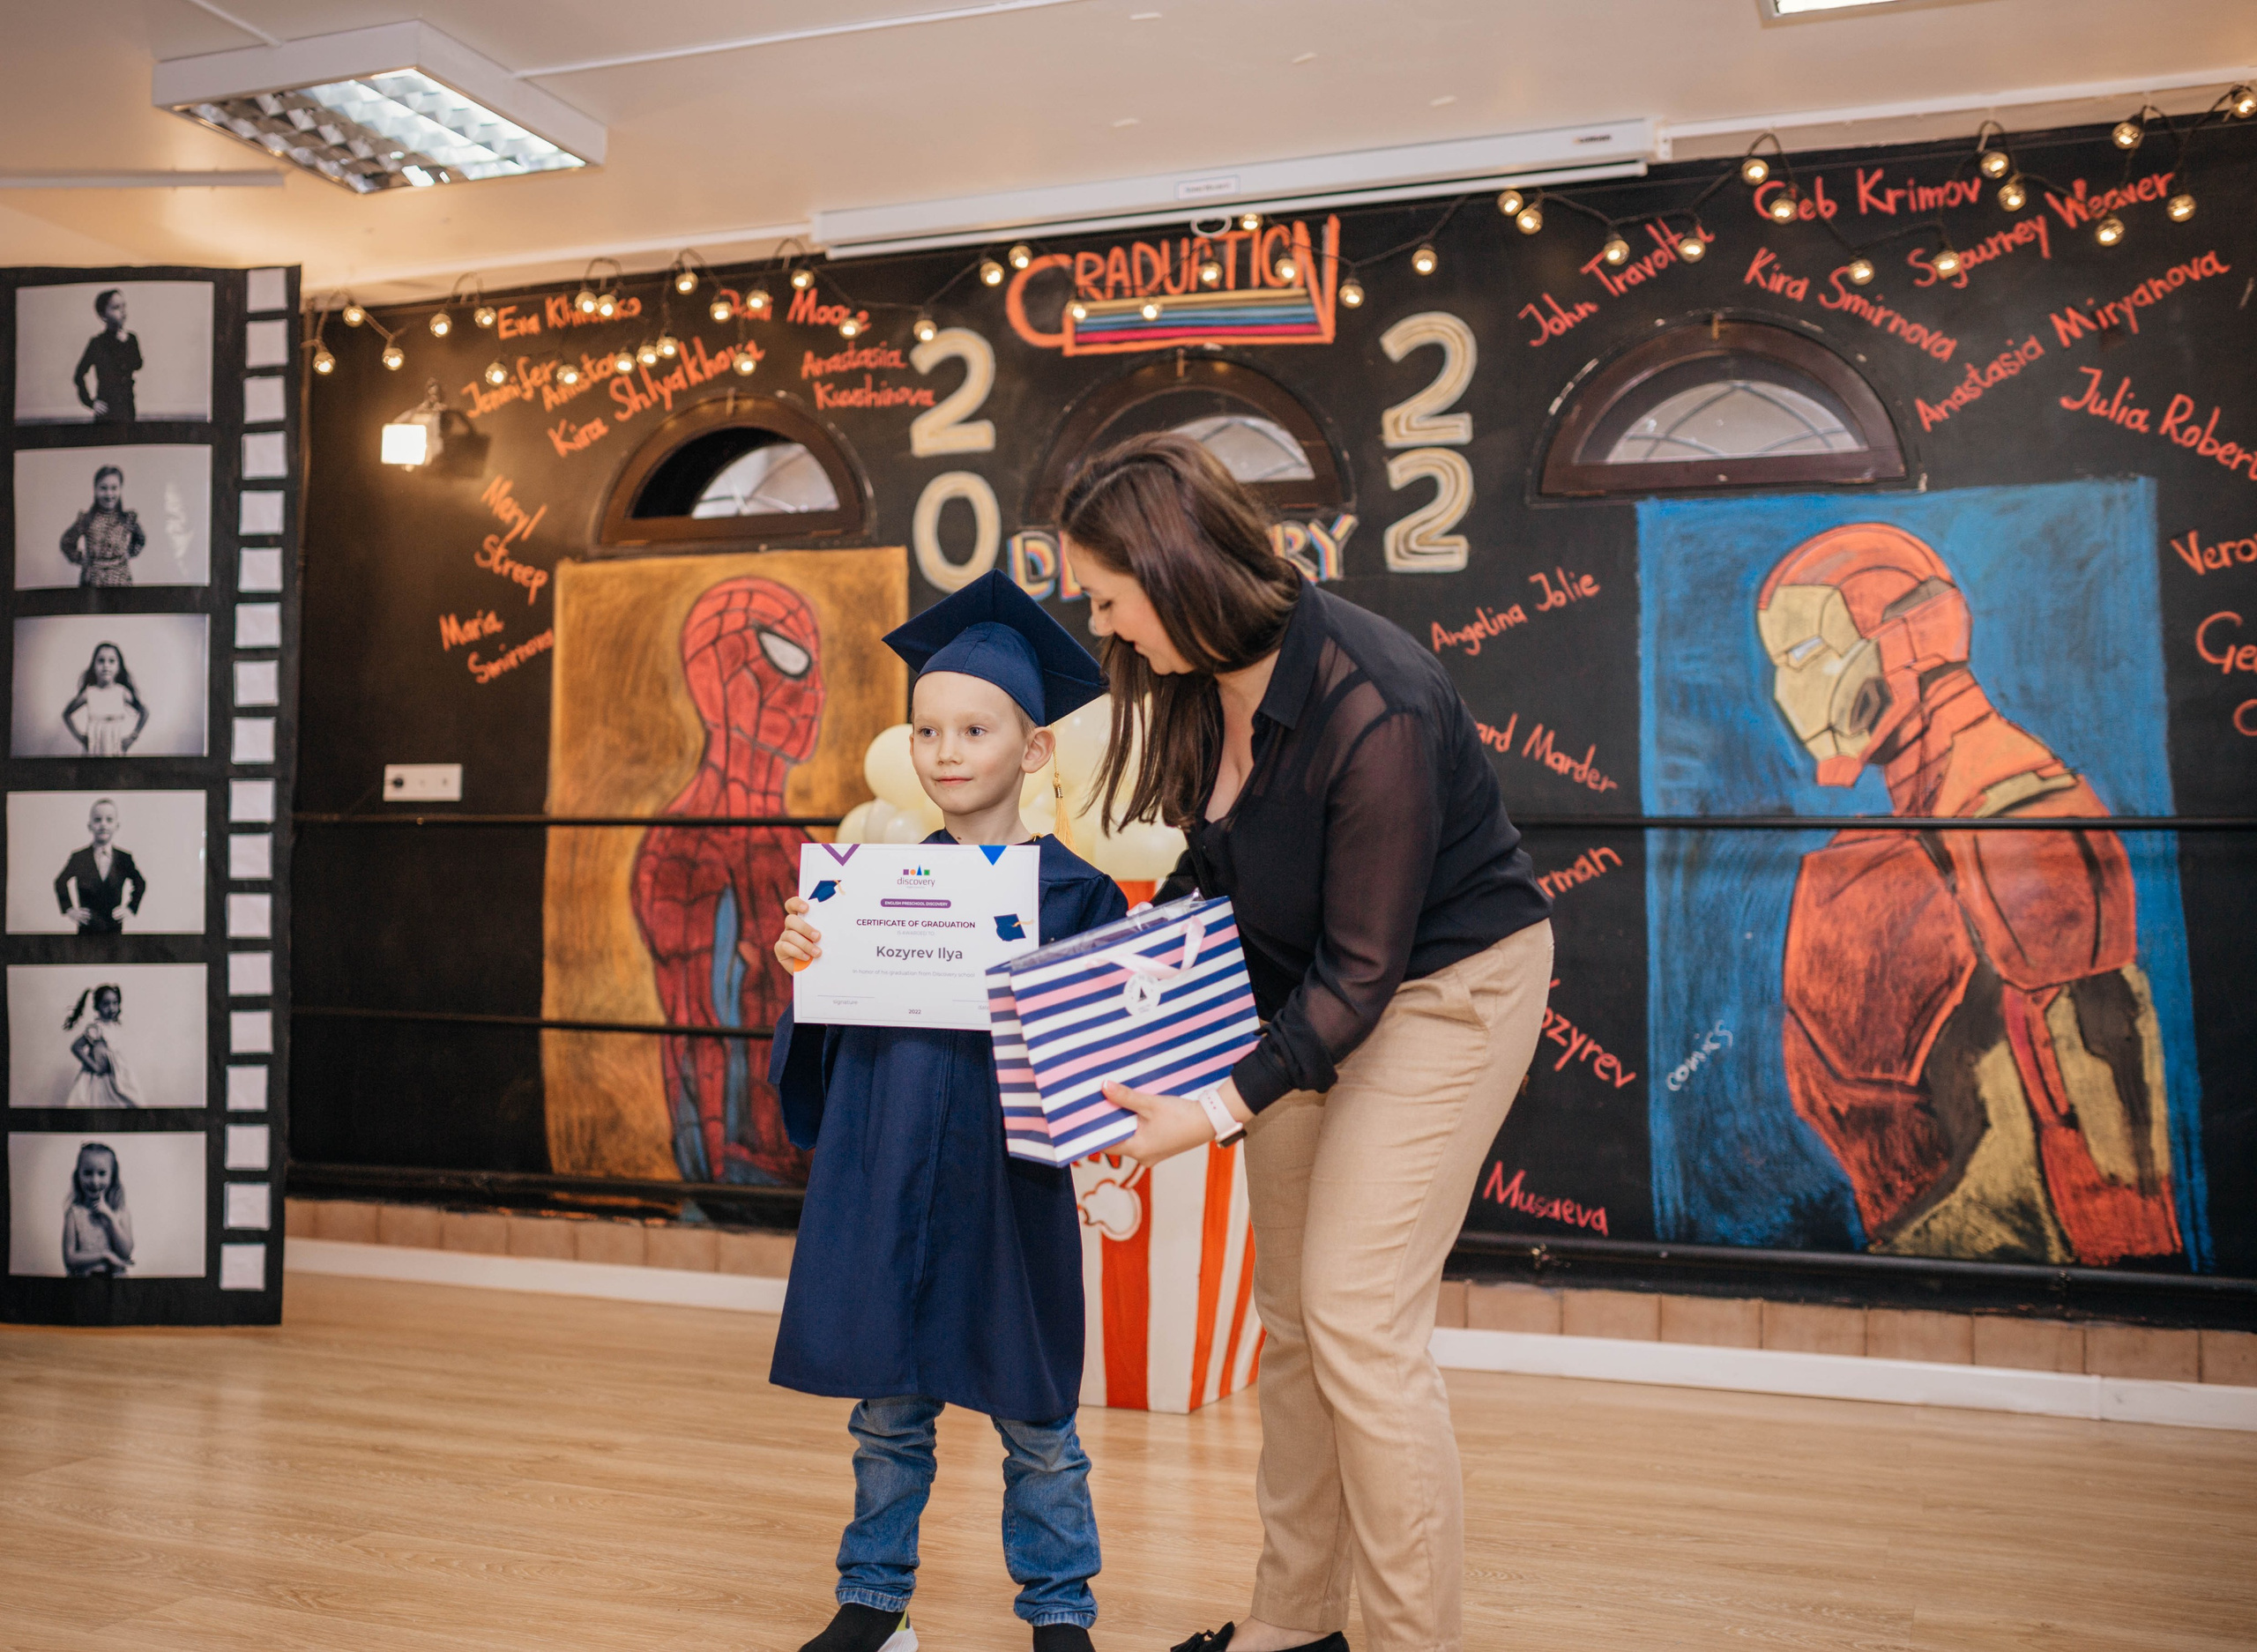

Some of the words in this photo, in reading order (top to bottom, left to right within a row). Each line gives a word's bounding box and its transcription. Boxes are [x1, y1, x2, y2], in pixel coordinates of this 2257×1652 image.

[1857, 168, 1981, 215] Krimov
[2045, 171, 2175, 229] Weaver
[1006, 213, 1340, 357] GRADUATION
[1744, 247, 1810, 301] Kira
[1818, 265, 1958, 362] Smirnova
[1518, 293, 1598, 346] John
[1914, 334, 2045, 432] Anastasia
[2060, 366, 2150, 434] Julia
[547, 416, 609, 458] Kira
[474, 533, 548, 606] Streep
[439, 610, 505, 651] Maria
[1430, 604, 1528, 656] Angelina
[1529, 566, 1600, 612] Jolie
[1522, 723, 1618, 793] Marder
[897, 877, 935, 887] discovery
[876, 946, 934, 960] Kozyrev
[938, 947, 963, 962] Ilya
[1482, 1160, 1609, 1237] Musaeva
